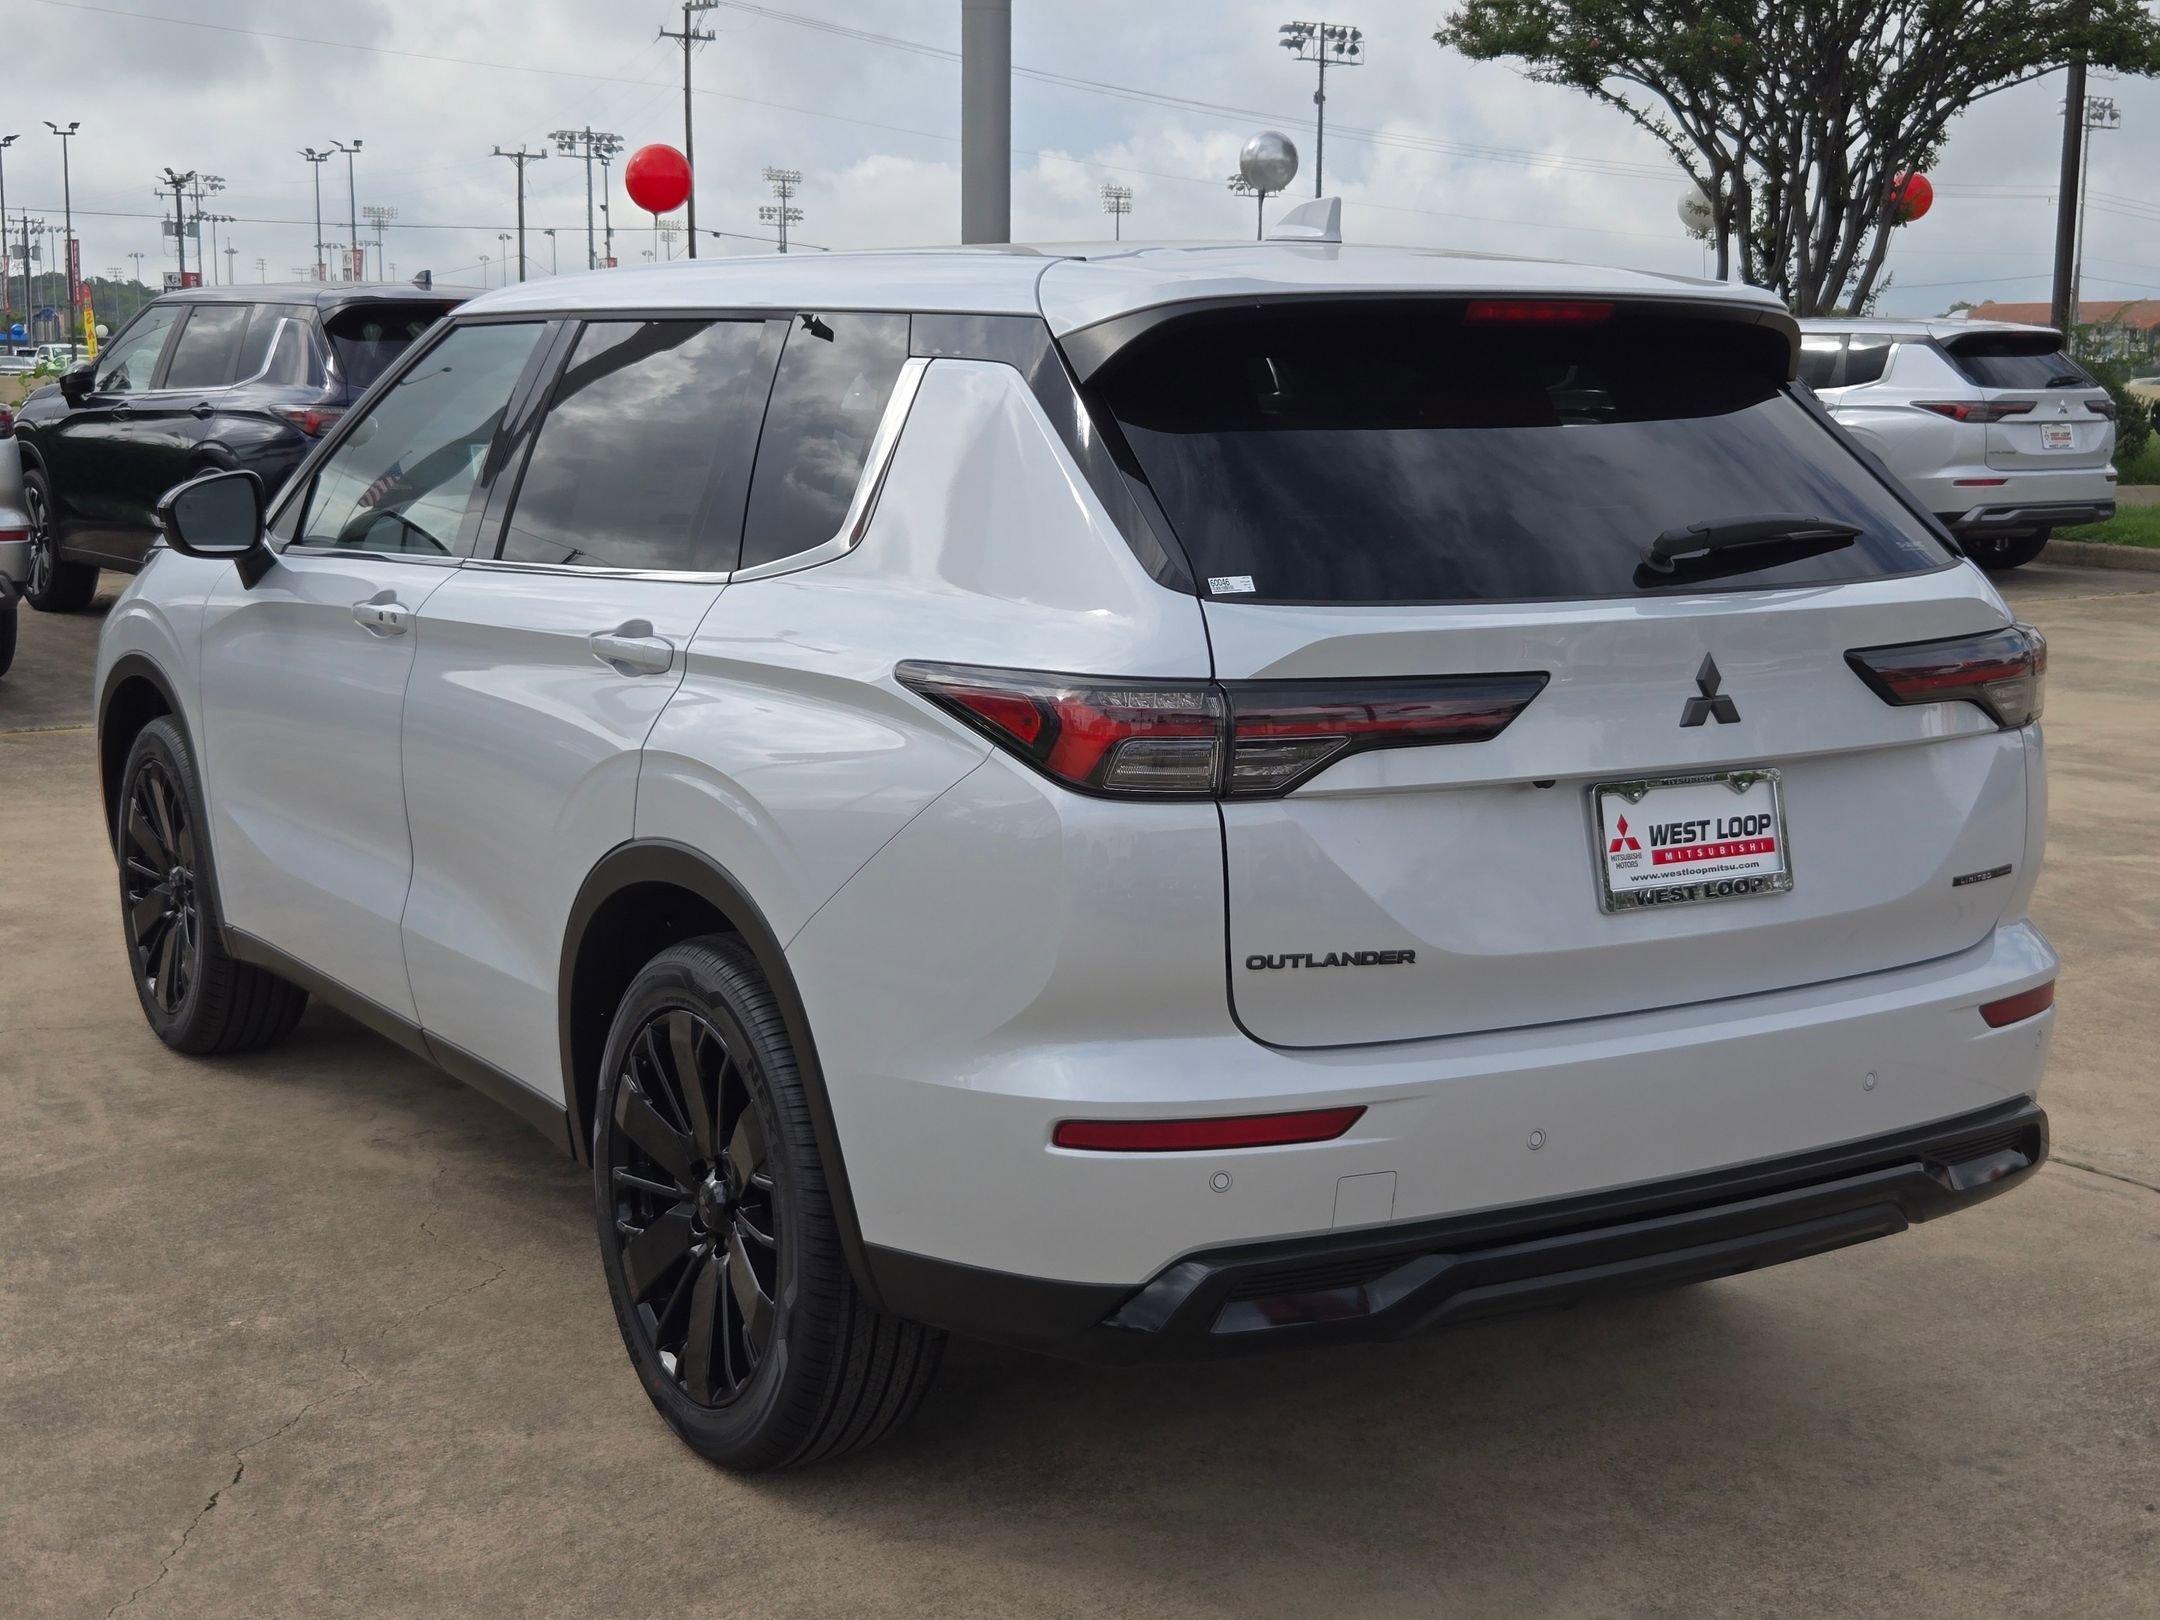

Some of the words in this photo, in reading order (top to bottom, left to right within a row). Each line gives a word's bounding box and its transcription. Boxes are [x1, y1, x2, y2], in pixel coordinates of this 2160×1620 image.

[1649, 820, 1711, 847] WEST
[1716, 813, 1772, 840] LOOP
[1611, 852, 1642, 862] MITSUBISHI
[1665, 842, 1765, 861] MITSUBISHI
[1616, 860, 1639, 869] MOTORS
[1630, 860, 1760, 882] www.westloopmitsu.com
[1633, 883, 1698, 905] WEST
[1704, 877, 1764, 898] LOOP
[1245, 949, 1416, 970] OUTLANDER
